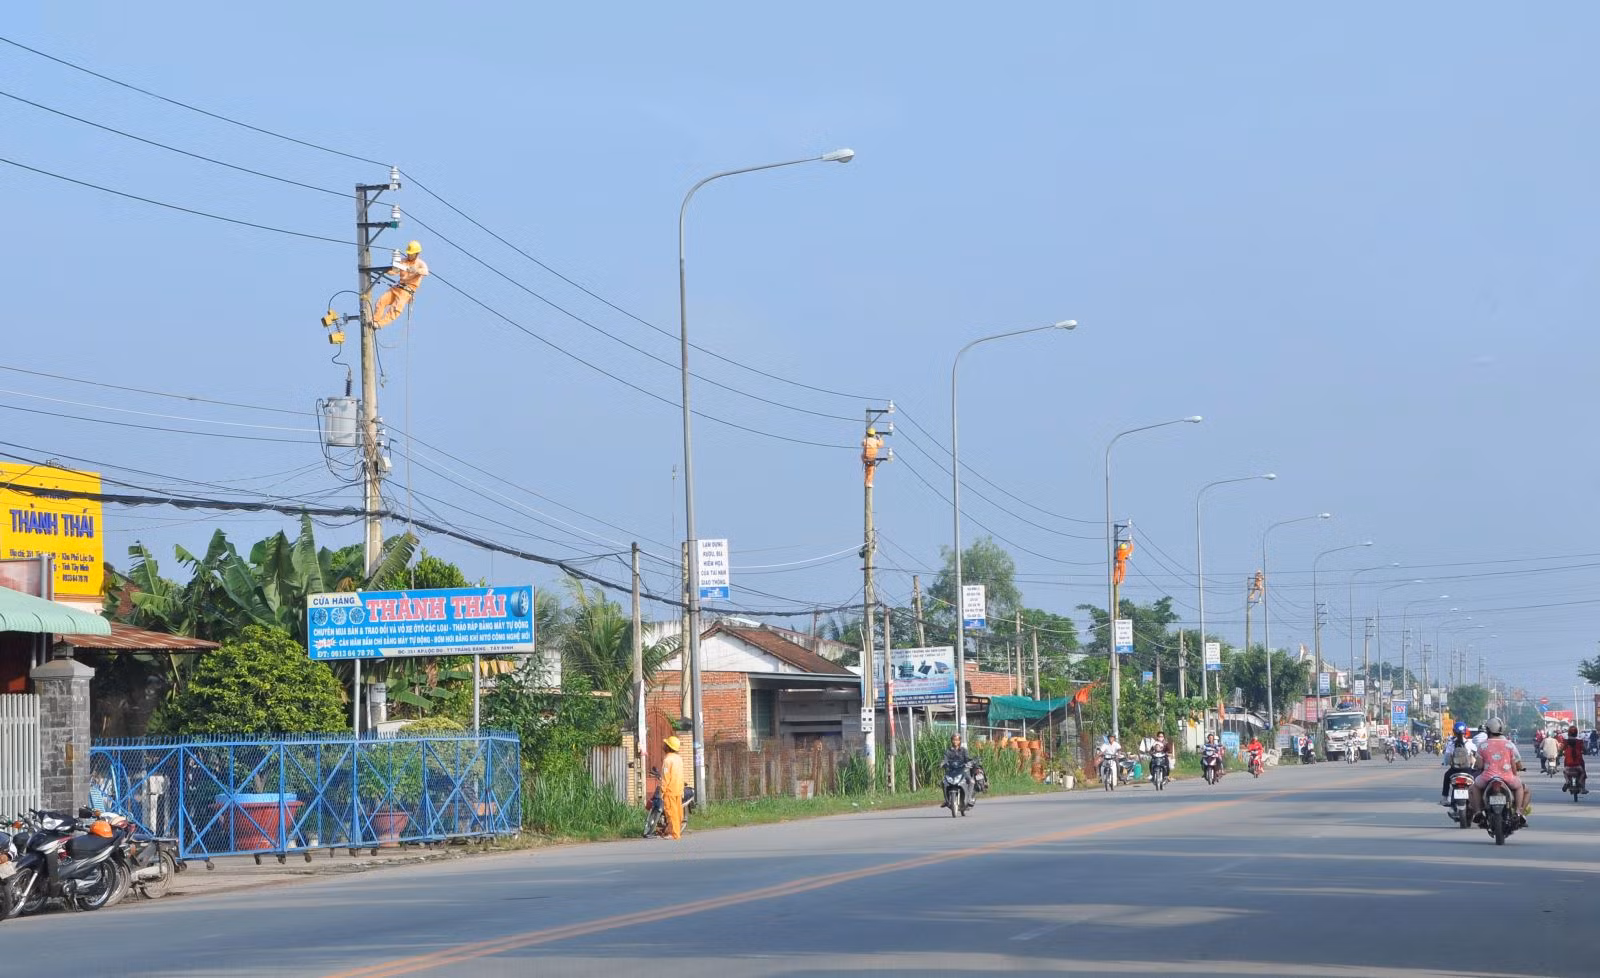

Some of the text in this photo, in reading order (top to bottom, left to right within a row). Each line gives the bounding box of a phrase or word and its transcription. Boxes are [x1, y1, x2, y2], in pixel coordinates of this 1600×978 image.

[9, 502, 94, 539] THÀNH THÁI
[313, 595, 355, 605] CỬA HÀNG
[366, 589, 507, 622] THÀNH THÁI
[313, 626, 334, 636] CHUYÊN
[406, 625, 413, 633] XE
[425, 624, 436, 632] CÁC
[437, 624, 448, 634] LOẠI
[479, 620, 493, 630] BẰNG
[494, 620, 505, 630] MÁY
[506, 621, 513, 631] TỰ
[514, 619, 529, 630] ĐỘNG
[397, 635, 408, 644] MÁY
[409, 636, 416, 645] TỰ
[417, 635, 430, 645] ĐỘNG
